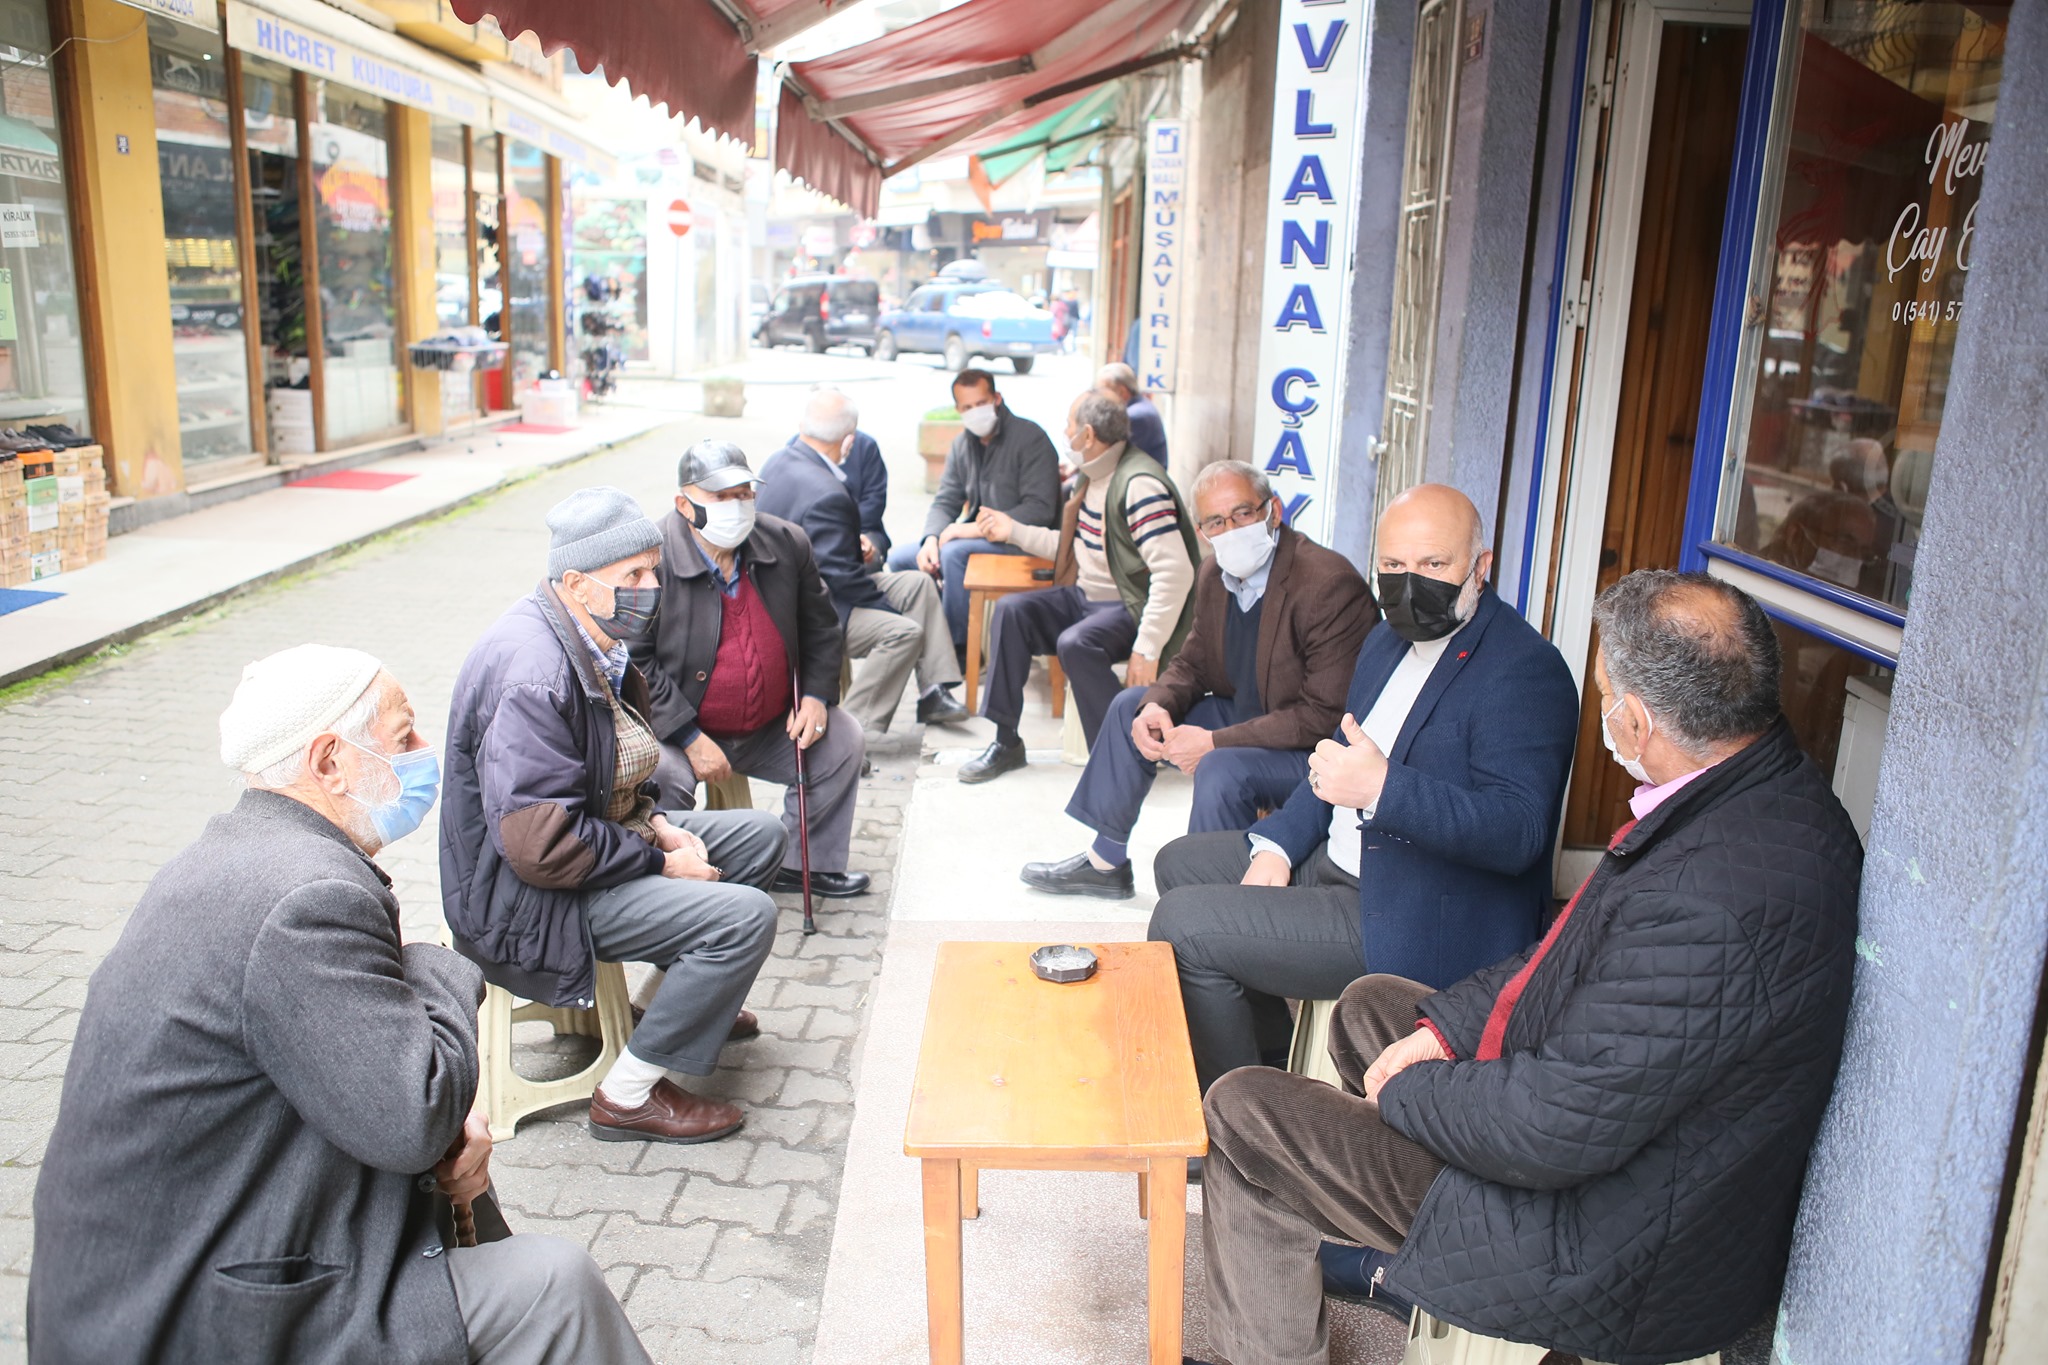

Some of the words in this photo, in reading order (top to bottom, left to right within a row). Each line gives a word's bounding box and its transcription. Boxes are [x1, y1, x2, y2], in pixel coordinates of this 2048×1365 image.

[256, 18, 336, 72] HİCRET
[352, 55, 433, 105] KUNDURA
[1273, 0, 1348, 333] VLANA
[1925, 118, 1989, 195] Mev
[3, 209, 32, 222] KİRALIK
[1945, 301, 1964, 321] 57
[1264, 367, 1320, 530] ÇAY
